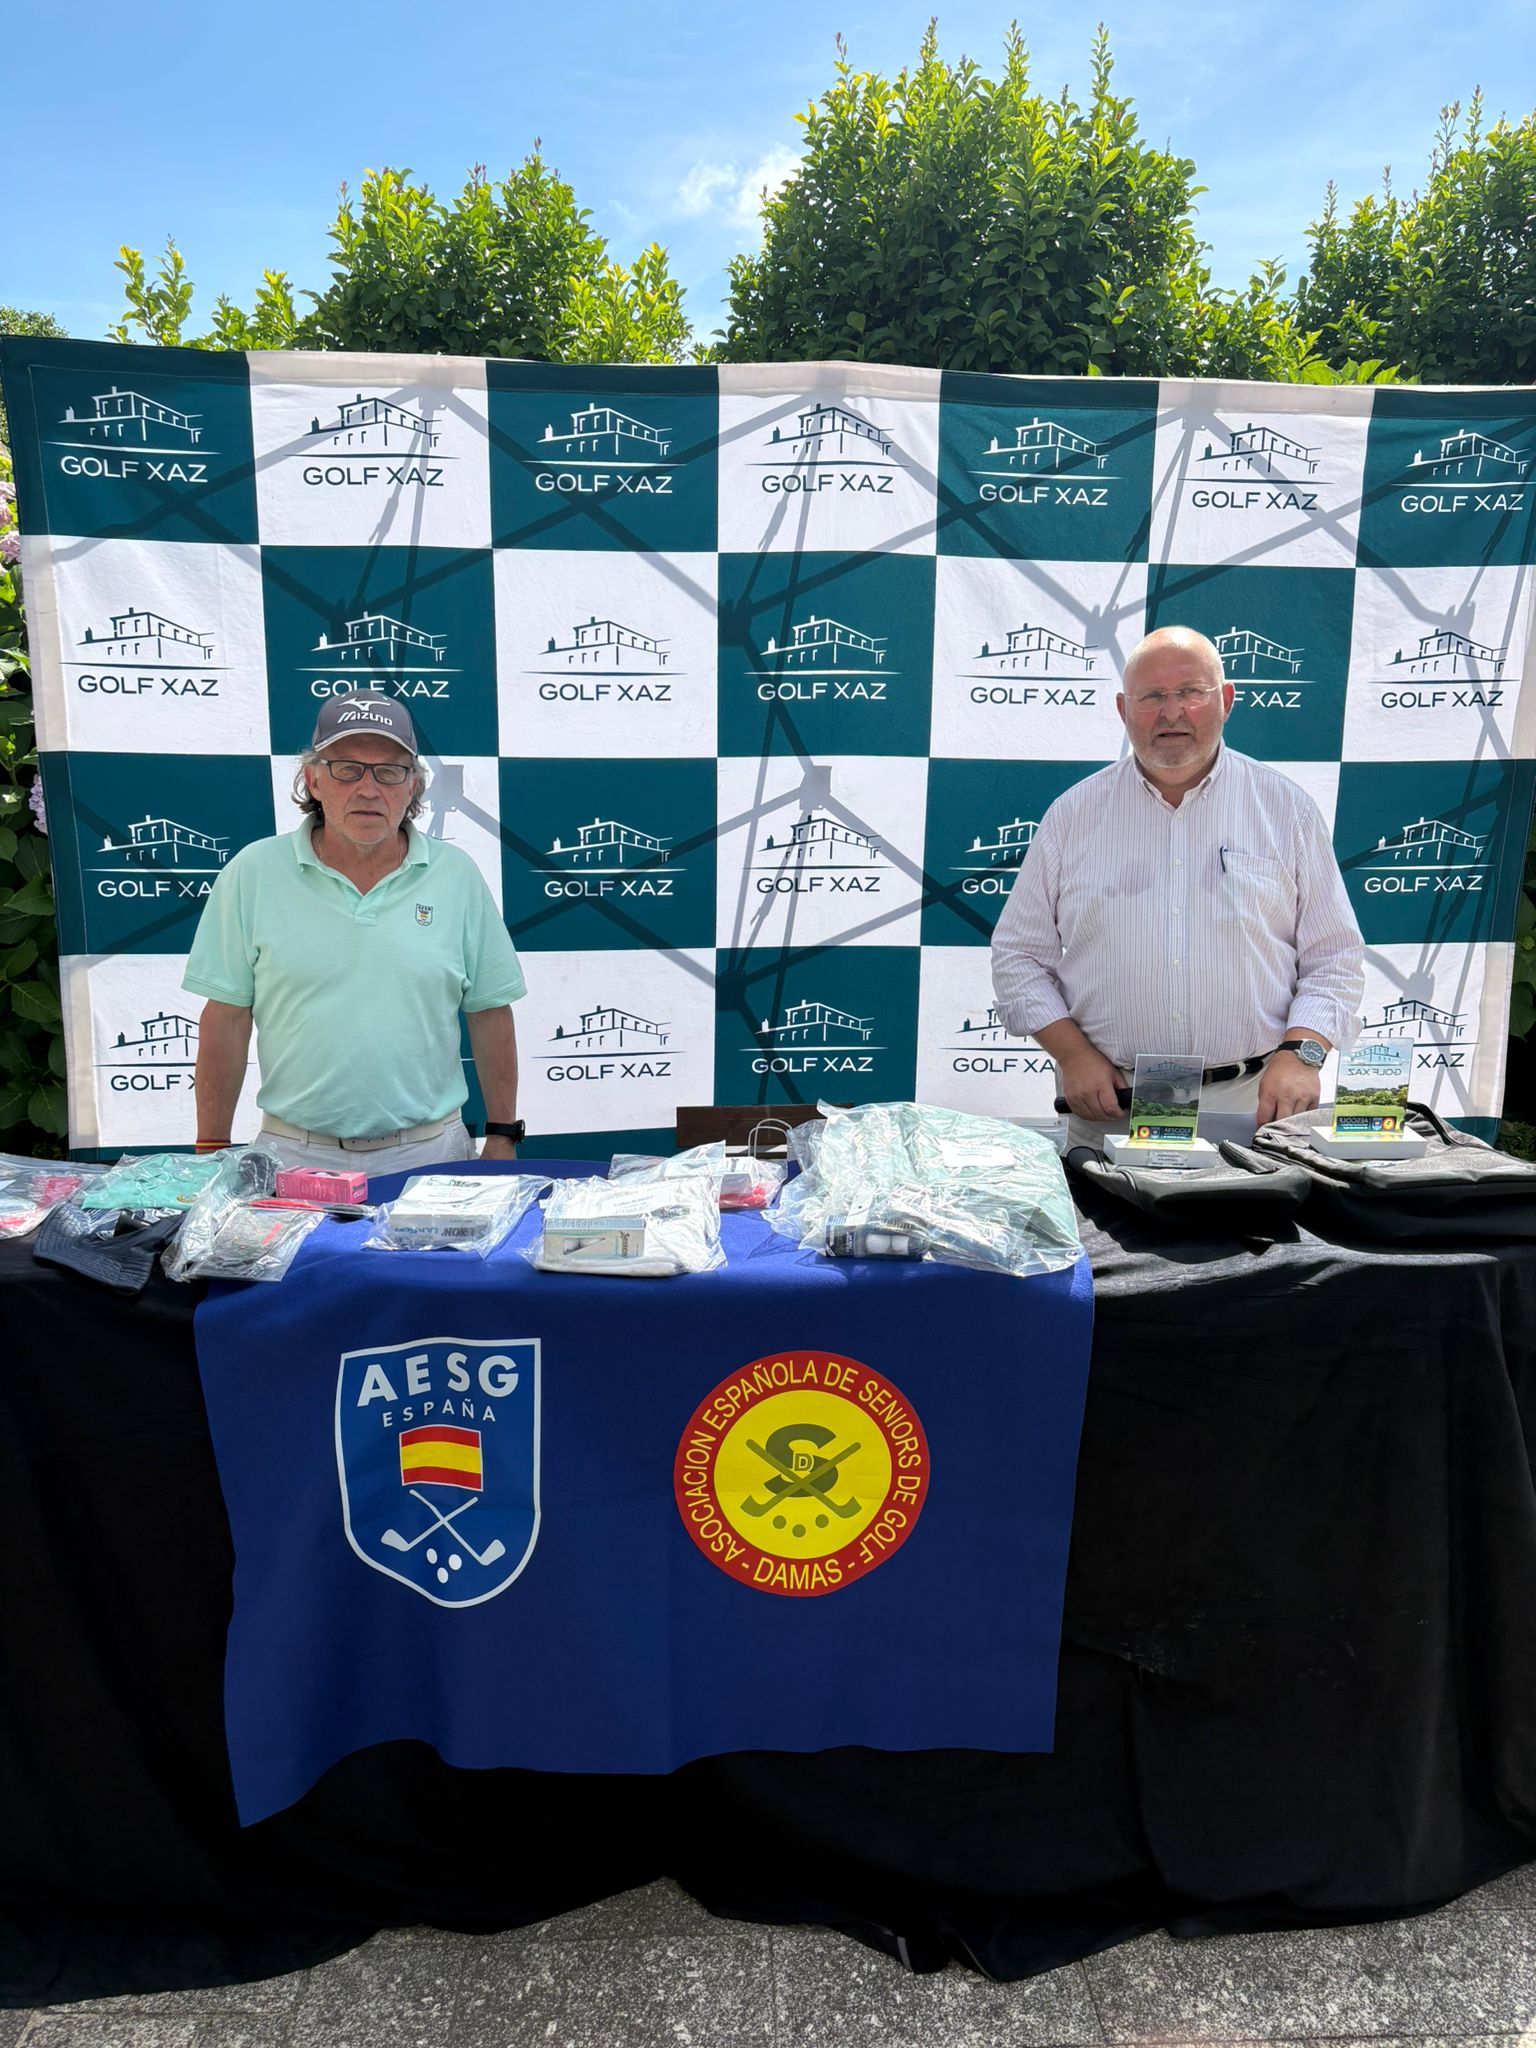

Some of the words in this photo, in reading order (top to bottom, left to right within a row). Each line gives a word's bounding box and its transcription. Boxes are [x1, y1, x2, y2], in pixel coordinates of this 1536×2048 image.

[60, 455, 140, 479] GOLF
[145, 461, 208, 483] XAZ
[302, 466, 380, 486] GOLF
[386, 466, 444, 487] XAZ
[535, 472, 611, 493] GOLF
[616, 474, 673, 494] XAZ
[761, 474, 835, 494] GOLF
[839, 474, 894, 494] XAZ
[979, 483, 1050, 504] GOLF
[1054, 487, 1109, 506] XAZ
[1191, 490, 1261, 509] GOLF
[1265, 491, 1319, 512] XAZ
[1400, 494, 1469, 513] GOLF
[1474, 493, 1524, 512] XAZ
[77, 674, 155, 695] GOLF
[160, 677, 220, 697] XAZ
[393, 679, 450, 698] XAZ
[538, 683, 612, 701] GOLF
[617, 684, 672, 702] XAZ
[757, 682, 828, 701] GOLF
[833, 681, 887, 700] XAZ
[970, 686, 1040, 705] GOLF
[1043, 688, 1096, 706] XAZ
[1250, 690, 1302, 708] XAZ
[1381, 691, 1448, 709] GOLF
[1451, 690, 1504, 708] XAZ
[97, 879, 171, 898] GOLF
[178, 880, 212, 898] XA
[544, 880, 615, 898] GOLF
[620, 879, 674, 897] XAZ
[756, 876, 825, 894] GOLF
[829, 876, 881, 893] XAZ
[962, 878, 1011, 895] GOL
[1364, 876, 1430, 894] GOLF
[1433, 874, 1483, 892] XAZ
[751, 1057, 819, 1074] GOLF
[823, 1056, 874, 1072] XAZ
[952, 1057, 1019, 1073] GOLF
[1023, 1058, 1055, 1074] XA
[1416, 1052, 1465, 1069] XAZ
[546, 1064, 615, 1082] GOLF
[620, 1061, 672, 1079] XAZ
[110, 1074, 182, 1092] GOLF
[356, 1351, 519, 1407] AESG
[823, 1362, 859, 1393] DE
[702, 1359, 818, 1431] ESPAÑOLA
[382, 1398, 496, 1427] ESPAÑA
[858, 1380, 922, 1469] SENIORS
[683, 1430, 746, 1562] ASOCIACION
[892, 1475, 921, 1505] DE
[859, 1509, 907, 1564] GOLF
[753, 1556, 843, 1590] DAMAS
